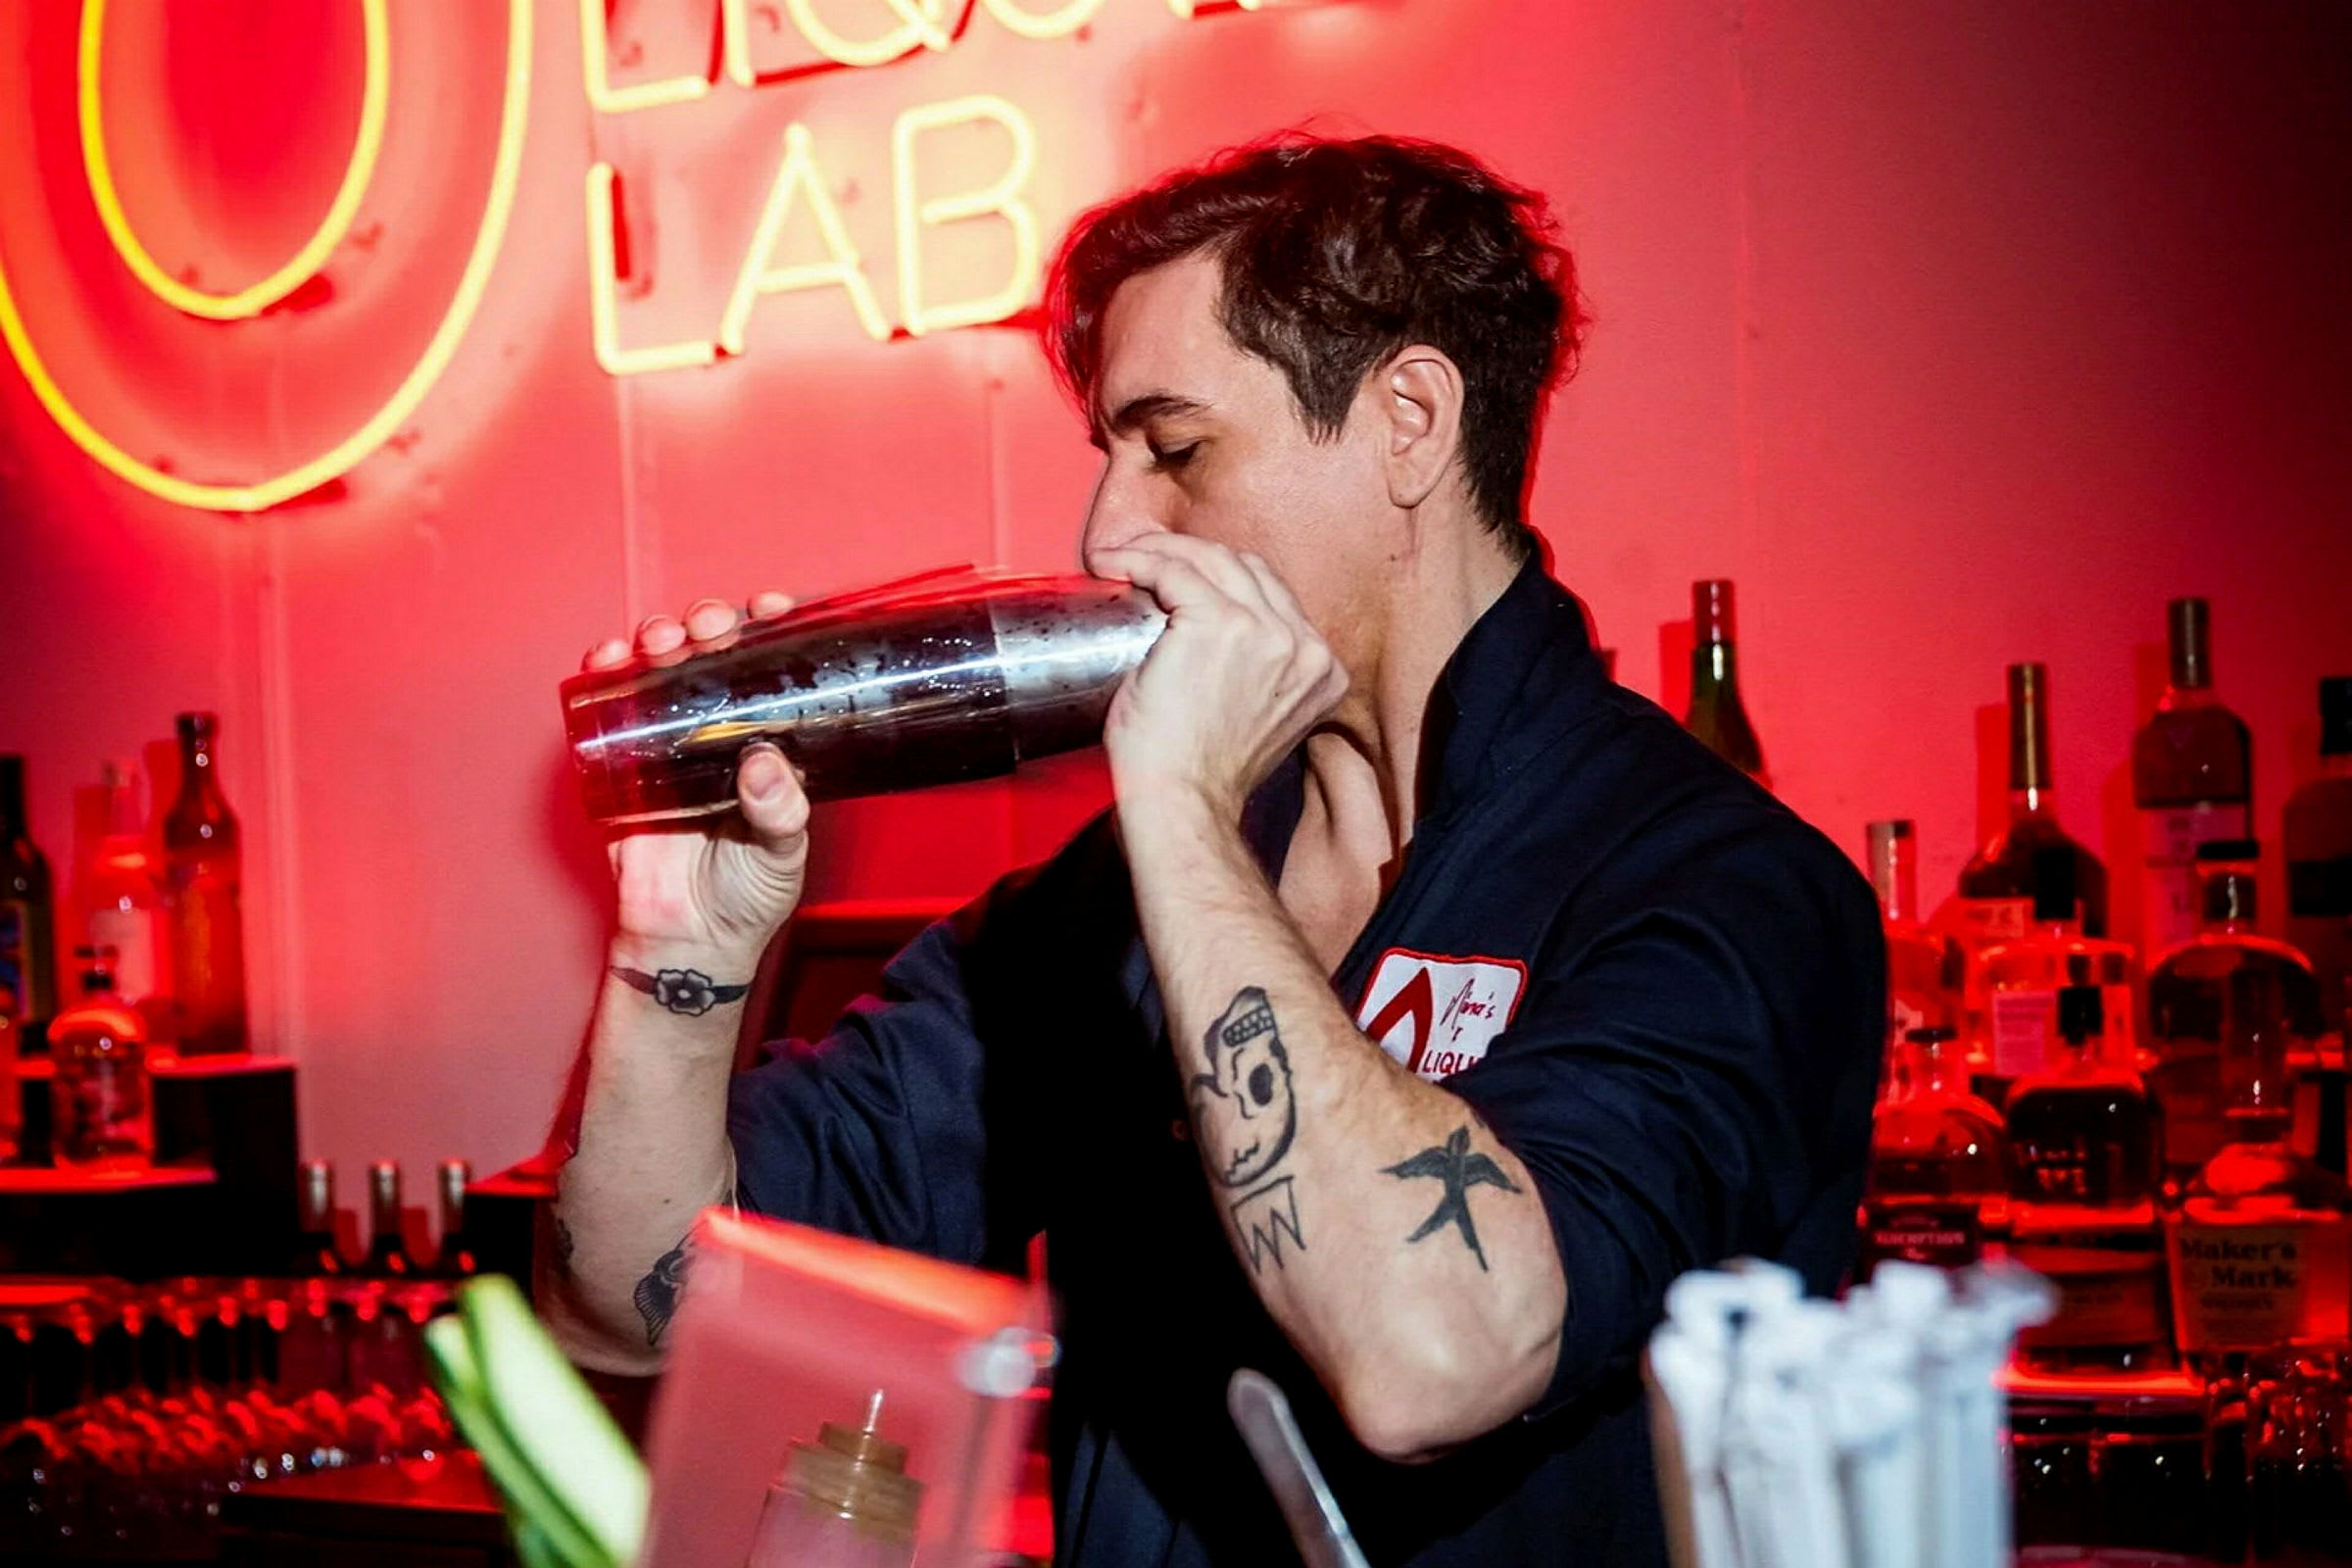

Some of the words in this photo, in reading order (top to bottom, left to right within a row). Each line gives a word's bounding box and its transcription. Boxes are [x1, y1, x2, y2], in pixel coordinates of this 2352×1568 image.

[586, 95, 1040, 374] LAB
[1421, 1050, 1478, 1074] LIQU
[2179, 1238, 2297, 1261] Maker's
[2211, 1266, 2297, 1289] Mark
